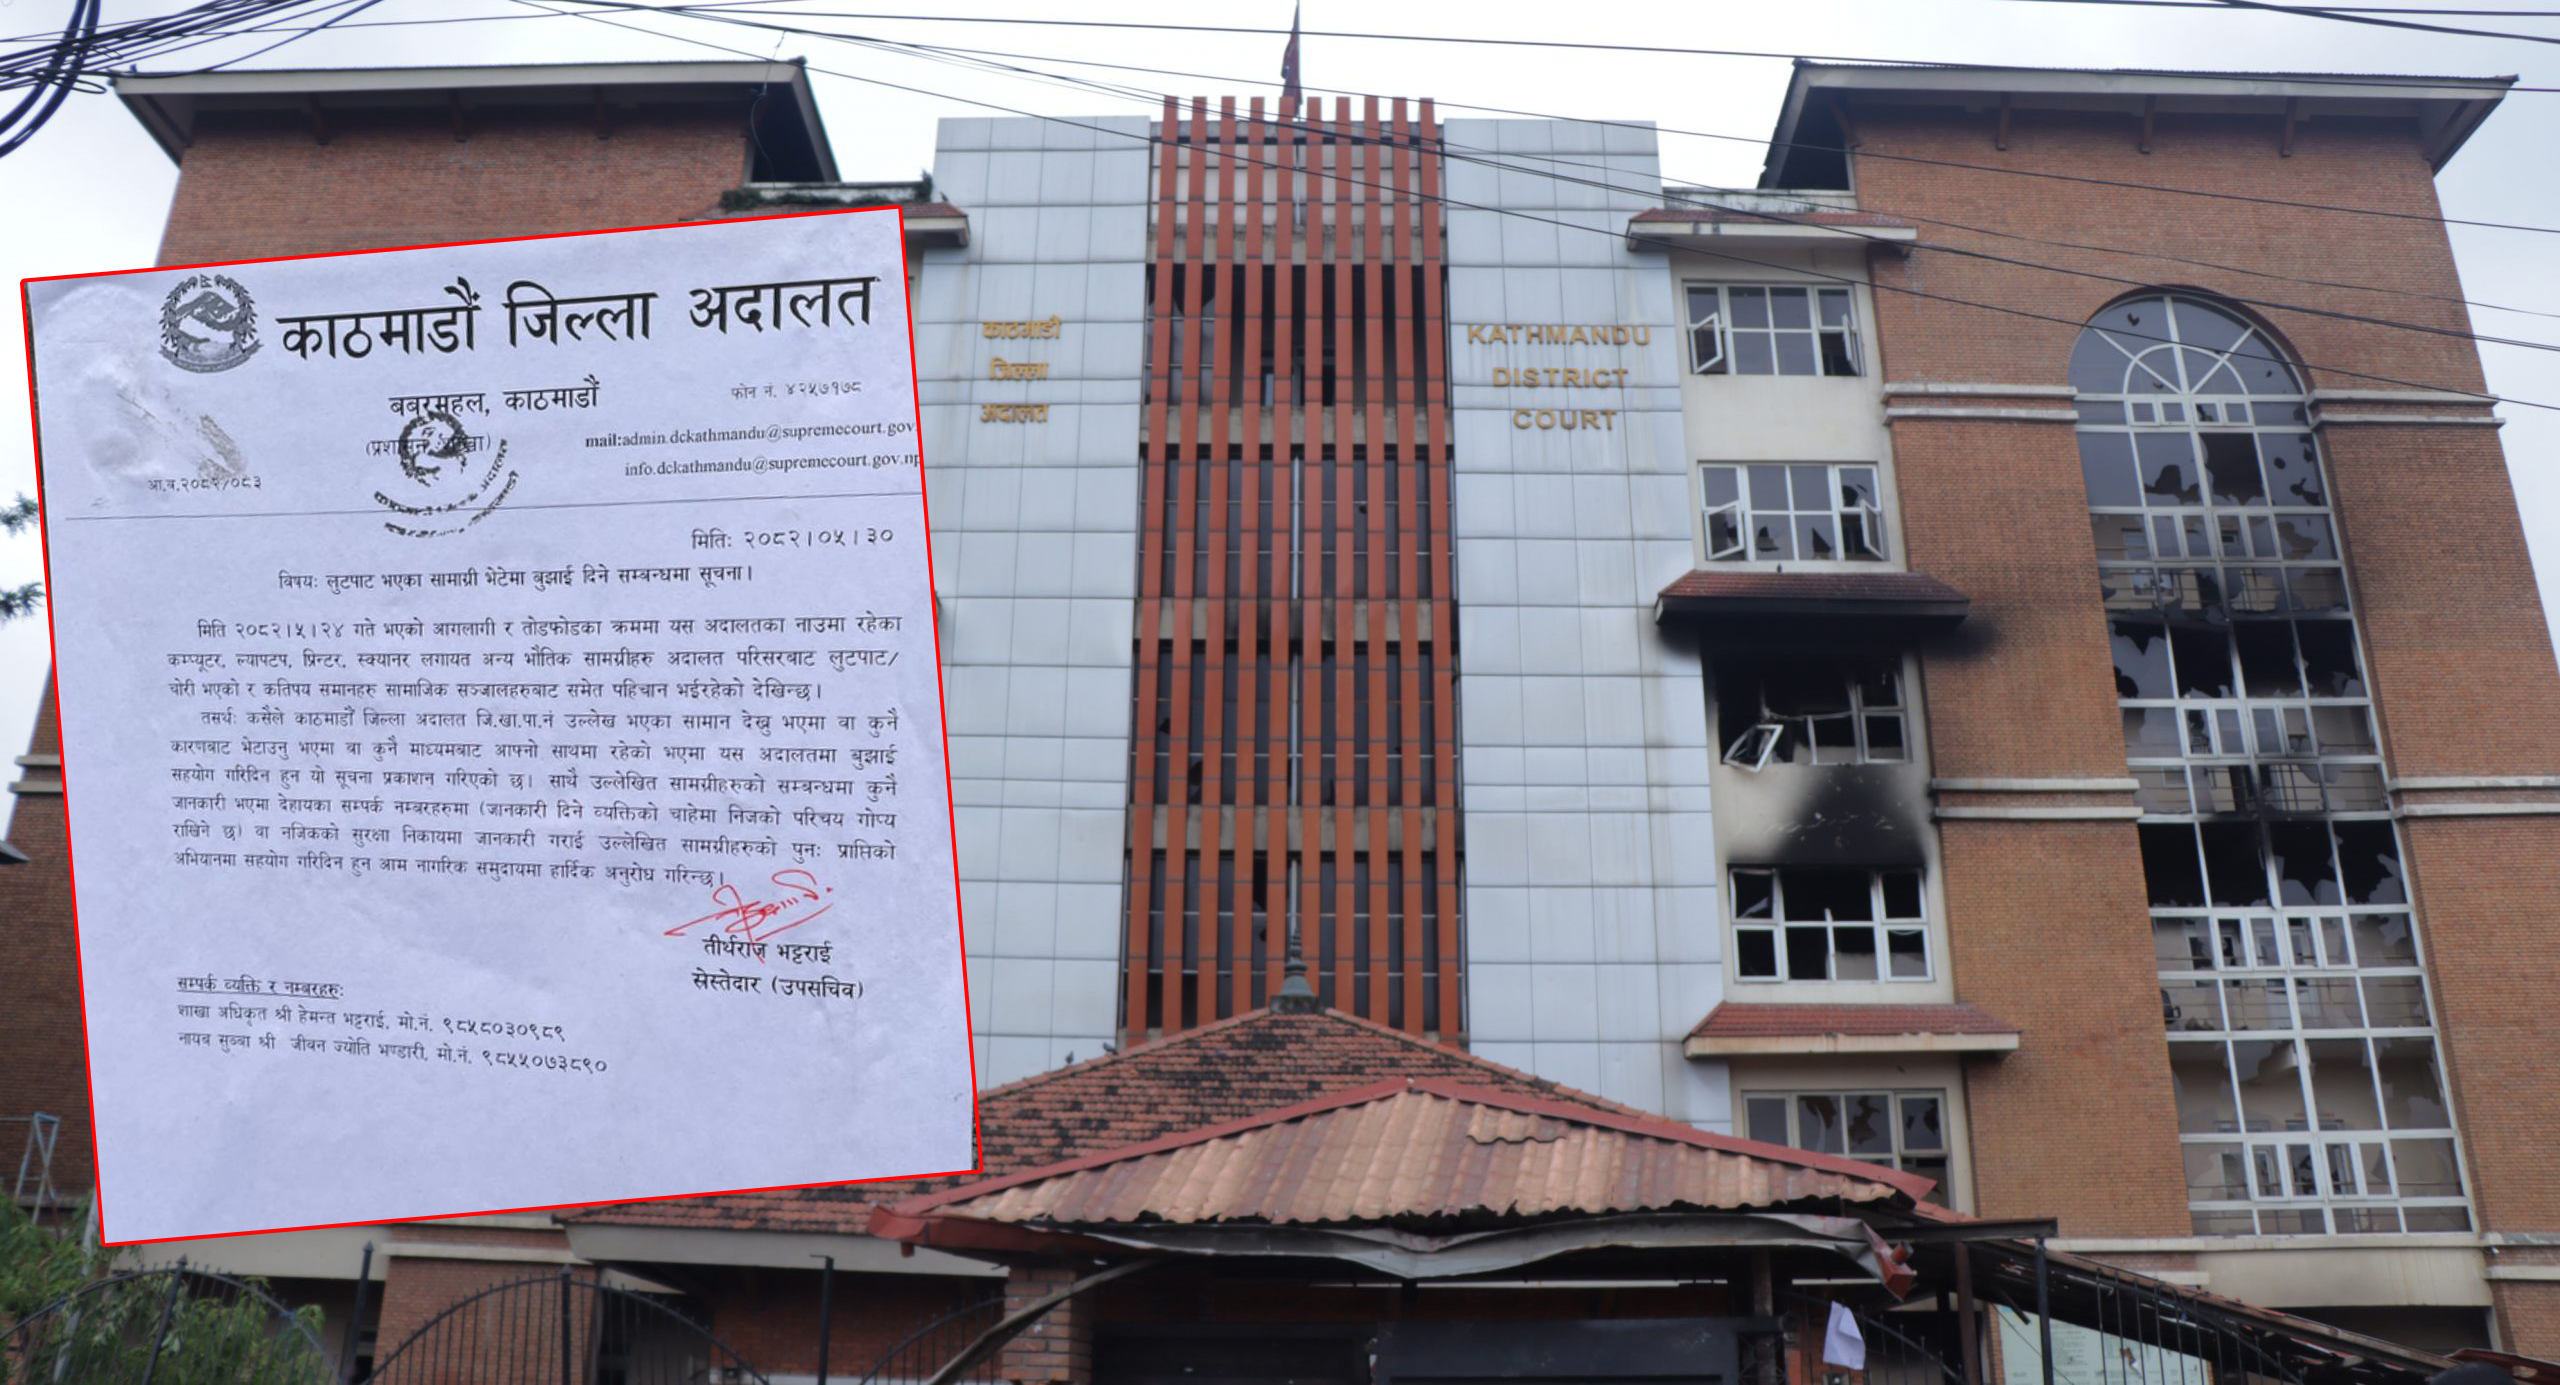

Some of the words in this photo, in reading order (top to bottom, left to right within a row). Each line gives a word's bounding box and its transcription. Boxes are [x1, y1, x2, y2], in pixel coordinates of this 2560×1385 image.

[501, 280, 659, 349] जिल्ला
[689, 276, 882, 335] अदालत
[1467, 324, 1650, 345] KATHMANDU
[1492, 367, 1629, 388] DISTRICT
[1512, 409, 1617, 430] COURT
[325, 573, 375, 596] लुटपाट
[382, 571, 423, 590] भएका
[533, 564, 573, 593] बुझाई
[582, 563, 610, 584] दिने
[616, 567, 691, 584] सम्बन्धमा
[197, 619, 226, 638] मिति
[352, 617, 377, 637] गते
[383, 617, 425, 640] भएको
[433, 617, 497, 636] आगलागी
[503, 621, 514, 637] र
[521, 615, 603, 637] तोडफोडका
[610, 620, 661, 635] क्रममा
[668, 620, 695, 635] यस
[704, 618, 786, 634] अदालतका
[855, 610, 903, 634] रहेका
[419, 653, 472, 667] लगायत
[482, 652, 515, 669] अन्य
[524, 644, 573, 667] भौतिक
[667, 651, 725, 668] अदालत
[735, 644, 817, 667] परिसरबाट
[202, 677, 240, 700] भएको
[246, 683, 256, 698] र
[262, 677, 312, 698] कतिपय
[386, 678, 450, 698] सामाजिक
[567, 678, 604, 698] समेत
[612, 677, 668, 699] पहिचान
[245, 704, 285, 726] कसैले
[363, 706, 406, 727] जिल्ला
[416, 712, 467, 727] अदालत
[564, 708, 616, 729] उल्लेख
[626, 714, 672, 733] भएका
[681, 714, 732, 734] सामान
[782, 712, 827, 734] भएमा
[837, 716, 857, 730] वा
[867, 707, 899, 738] कुनै
[298, 741, 335, 759] भएमा
[372, 735, 398, 762] कुनै
[549, 744, 600, 760] साथमा
[609, 739, 652, 762] रहेको
[663, 746, 706, 767] भएमा
[719, 746, 744, 761] यस
[759, 744, 837, 763] अदालतमा
[850, 744, 898, 771] बुझाई
[171, 763, 215, 783] सहयोग
[222, 763, 271, 786] गरिदिन
[279, 770, 301, 789] हुन
[311, 764, 325, 784] यो
[334, 766, 373, 790] सूचना
[445, 768, 498, 790] गरिएको
[548, 766, 579, 789] साथै
[588, 769, 659, 791] उल्लेखित
[776, 779, 856, 796] सम्बन्धमा
[866, 772, 898, 803] कुनै
[172, 792, 227, 812] जानकारी
[234, 794, 270, 814] भएमा
[340, 795, 384, 813] सम्पर्क
[556, 798, 584, 819] दिने
[669, 802, 718, 824] चाहेमा
[728, 803, 782, 827] निजको
[792, 806, 845, 829] परिचय
[351, 826, 390, 848] सुरक्षा
[473, 828, 537, 849] जानकारी
[547, 830, 585, 850] गराई
[598, 831, 669, 855] उल्लेखित
[174, 847, 237, 867] अभियानमा
[243, 849, 289, 869] सहयोग
[350, 857, 371, 877] हुन
[379, 858, 408, 871] आम
[415, 854, 469, 875] नागरिक
[475, 858, 543, 882] समुदायमा
[549, 858, 596, 879] हार्दिक
[605, 861, 656, 887] अनुरोध
[776, 940, 834, 965] भट्टराई
[268, 981, 278, 995] र
[177, 1004, 211, 1018] शाखा
[298, 1003, 336, 1025] हेमन्त
[258, 1032, 276, 1049] श्री
